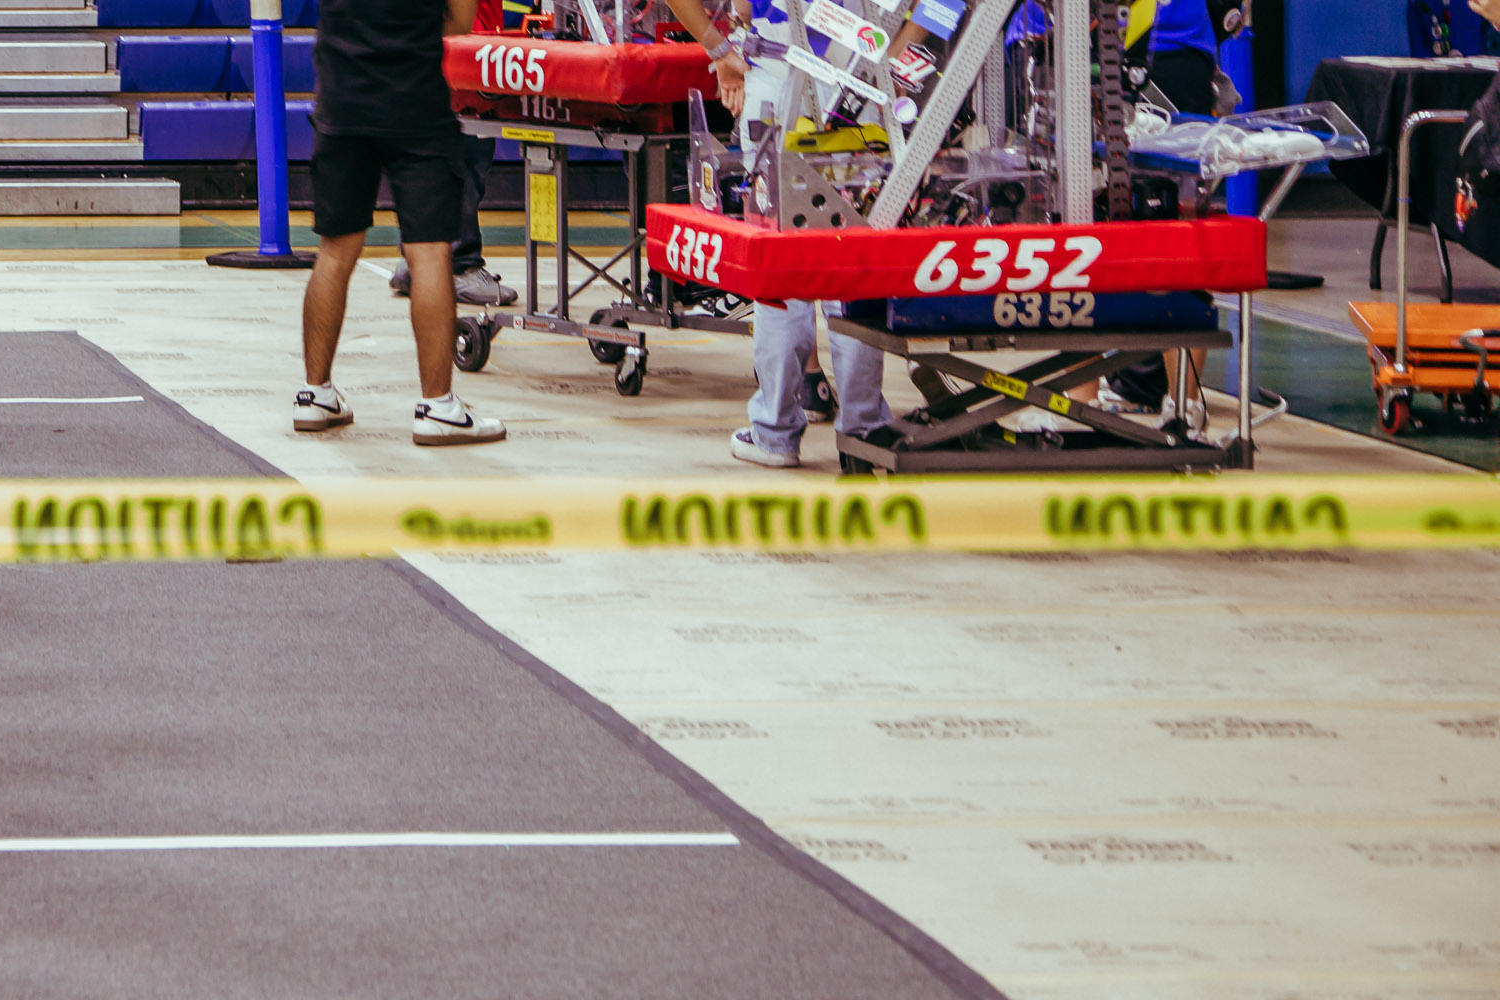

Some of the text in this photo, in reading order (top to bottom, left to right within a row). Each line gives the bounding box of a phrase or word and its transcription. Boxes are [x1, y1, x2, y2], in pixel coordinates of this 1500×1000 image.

[475, 43, 548, 93] 1165
[519, 95, 571, 121] 1165
[666, 224, 724, 285] 6352
[913, 235, 1103, 293] 6352
[993, 290, 1096, 328] 6352
